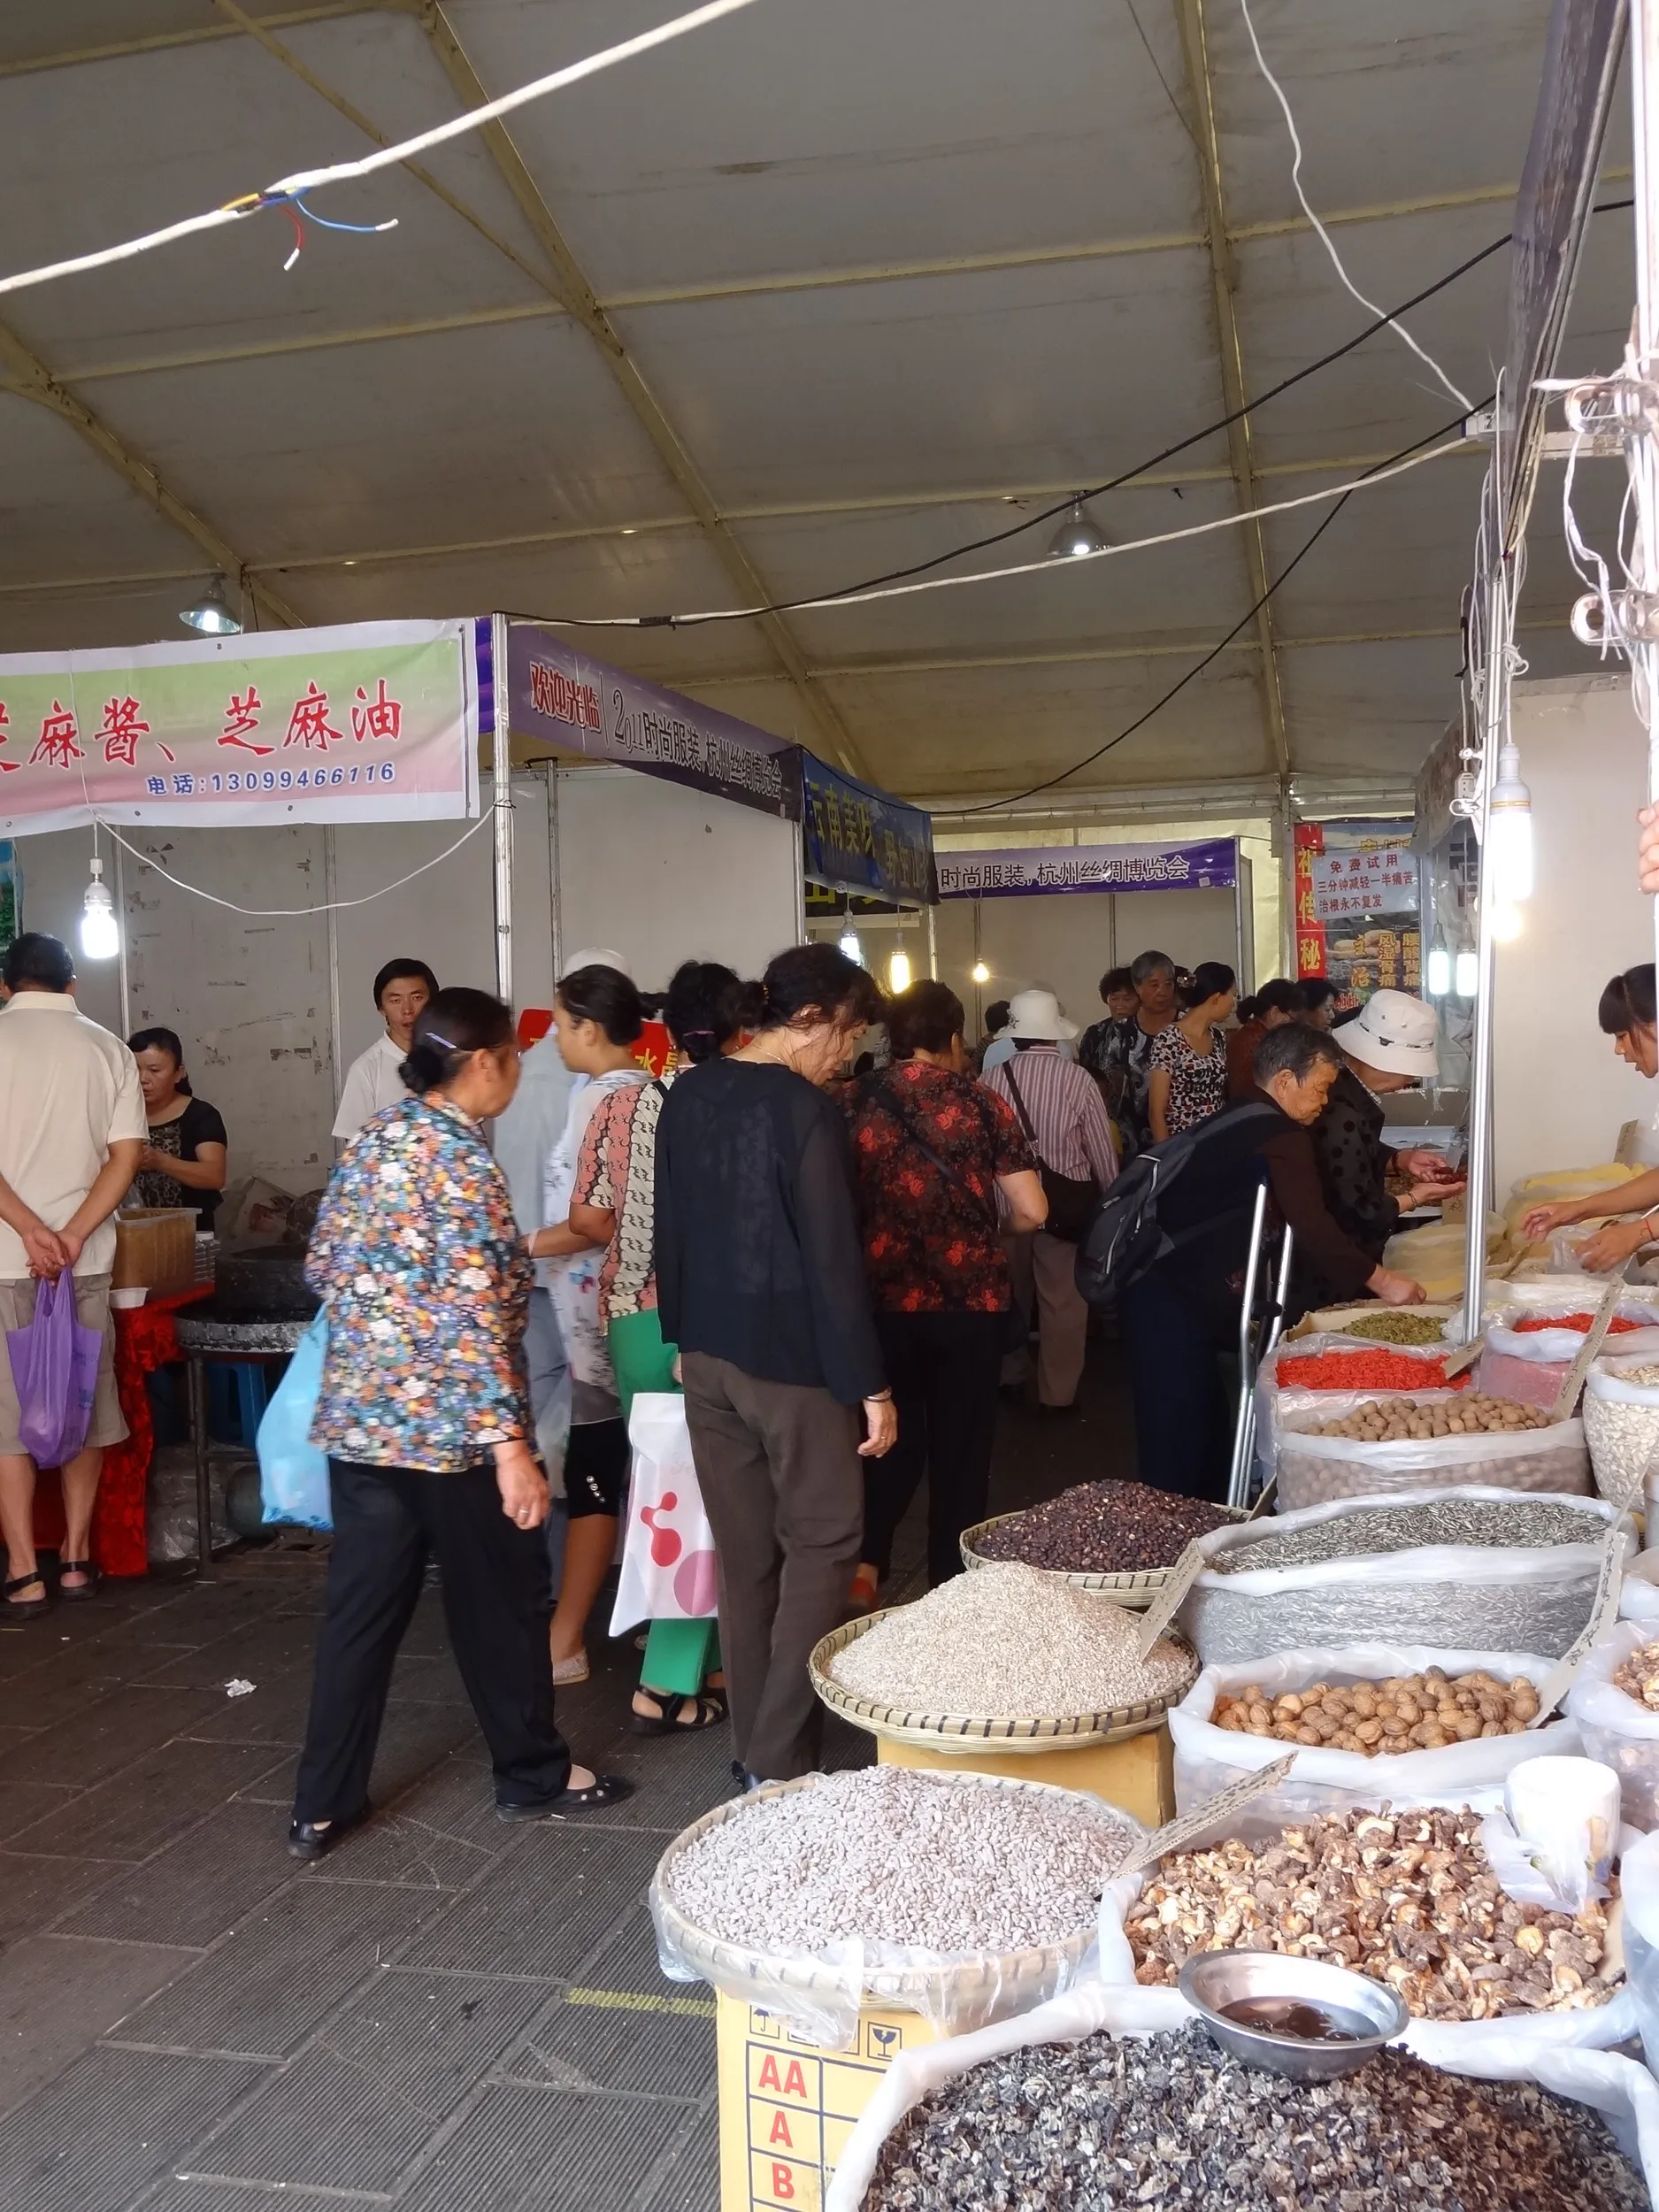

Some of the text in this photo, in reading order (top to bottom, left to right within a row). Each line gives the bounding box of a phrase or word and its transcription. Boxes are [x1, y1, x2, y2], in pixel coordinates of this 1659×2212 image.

[531, 662, 602, 733] 欢迎光临
[1317, 871, 1414, 894] 三分钟减轻一半痛苦
[1330, 854, 1399, 874] 免费试用
[1319, 894, 1382, 913] 治根永不复发
[1351, 934, 1371, 987] 主治
[1379, 933, 1397, 987] 风湿骨痛
[758, 2054, 808, 2100] AA
[769, 2109, 794, 2149] A
[772, 2162, 795, 2200] B
